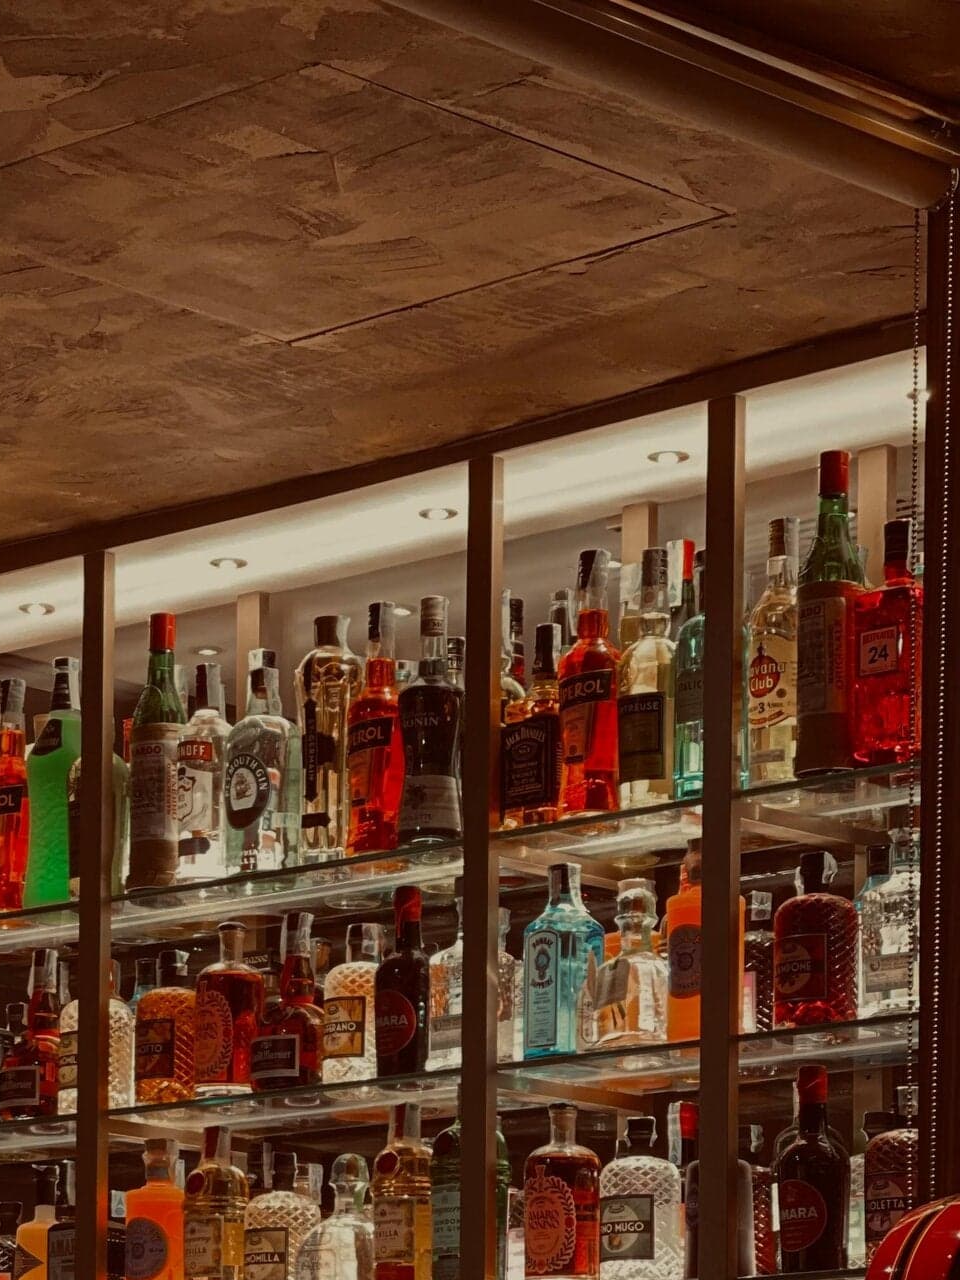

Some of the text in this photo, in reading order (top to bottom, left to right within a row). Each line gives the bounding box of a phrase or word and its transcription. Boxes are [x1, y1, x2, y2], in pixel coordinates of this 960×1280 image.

[868, 645, 889, 665] 24
[758, 702, 765, 714] 3
[615, 1221, 645, 1233] MUGO
